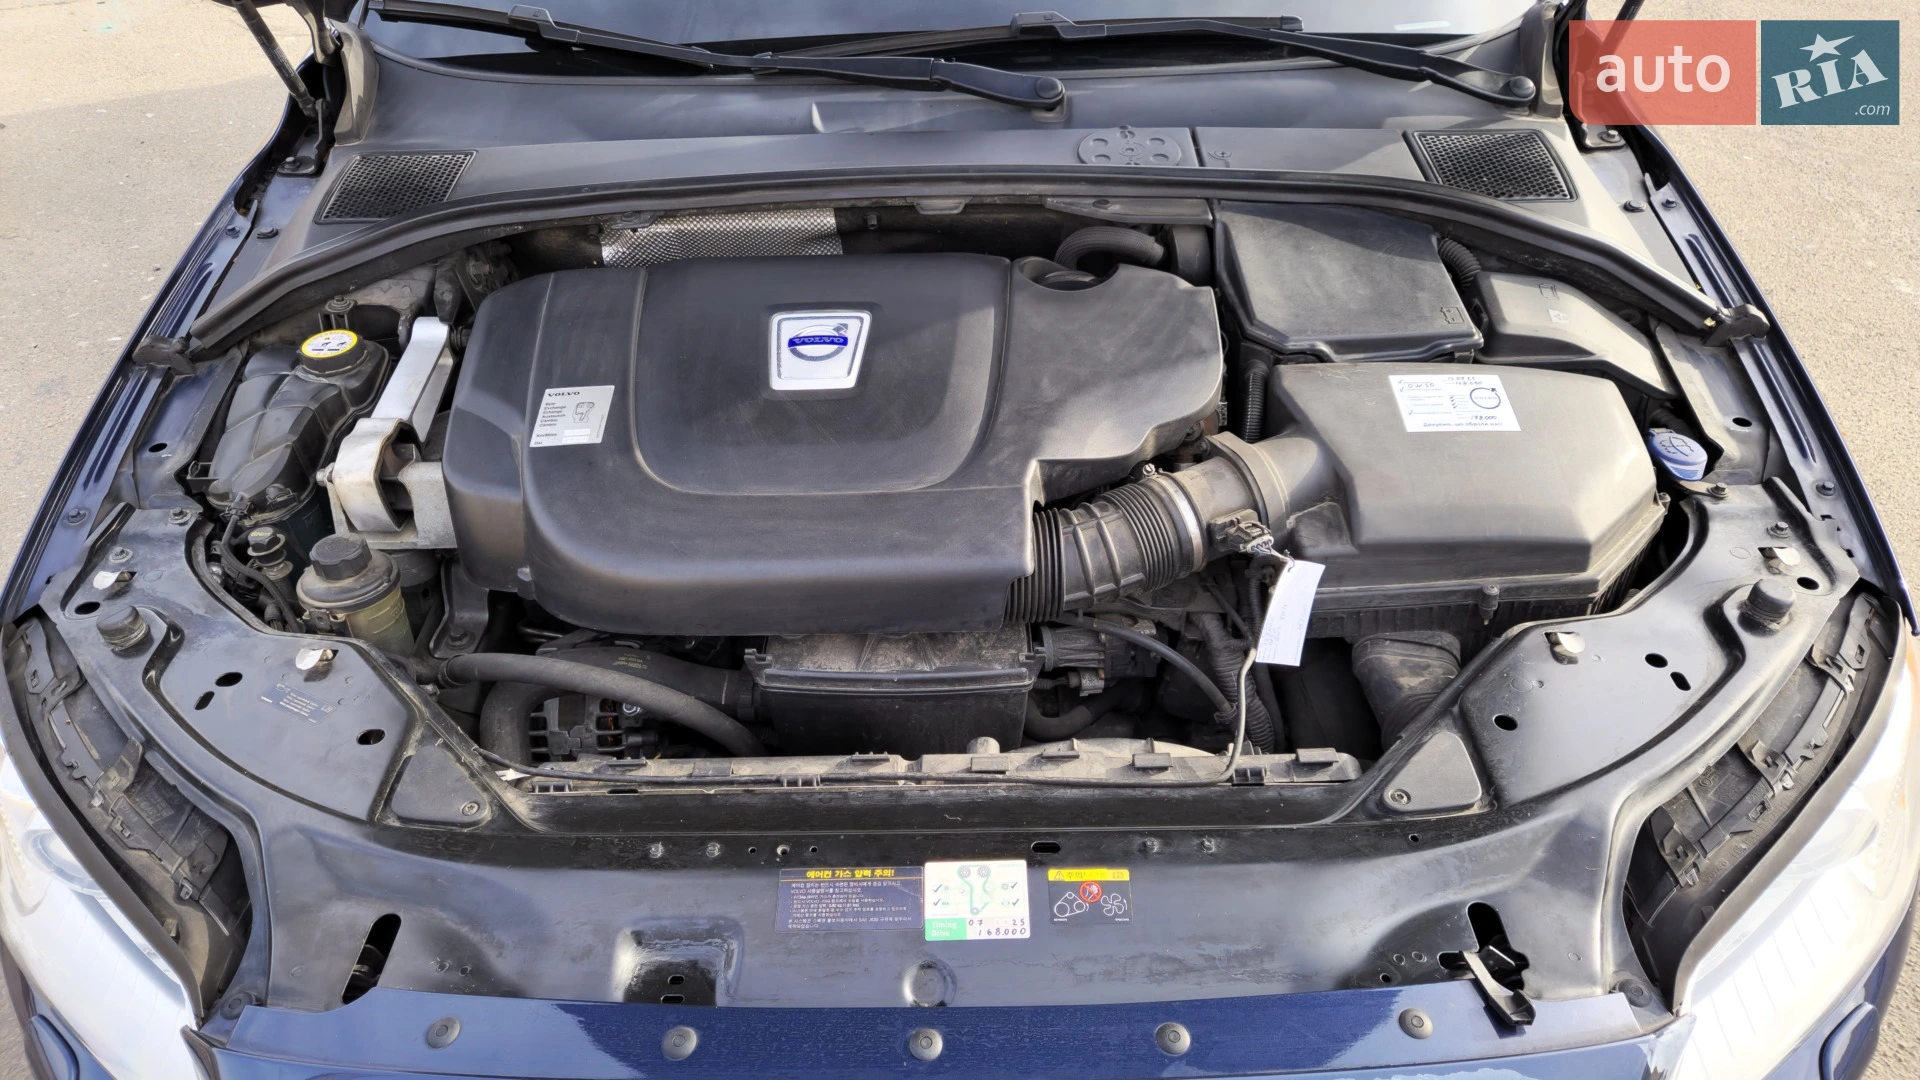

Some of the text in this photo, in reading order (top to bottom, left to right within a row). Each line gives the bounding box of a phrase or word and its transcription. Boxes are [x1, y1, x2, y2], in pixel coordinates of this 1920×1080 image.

[792, 336, 844, 344] VOLVO
[806, 869, 895, 879] 에어컨 가스 압력 주의!
[931, 921, 958, 930] Timing
[1012, 918, 1025, 926] 25
[931, 929, 951, 937] Drive
